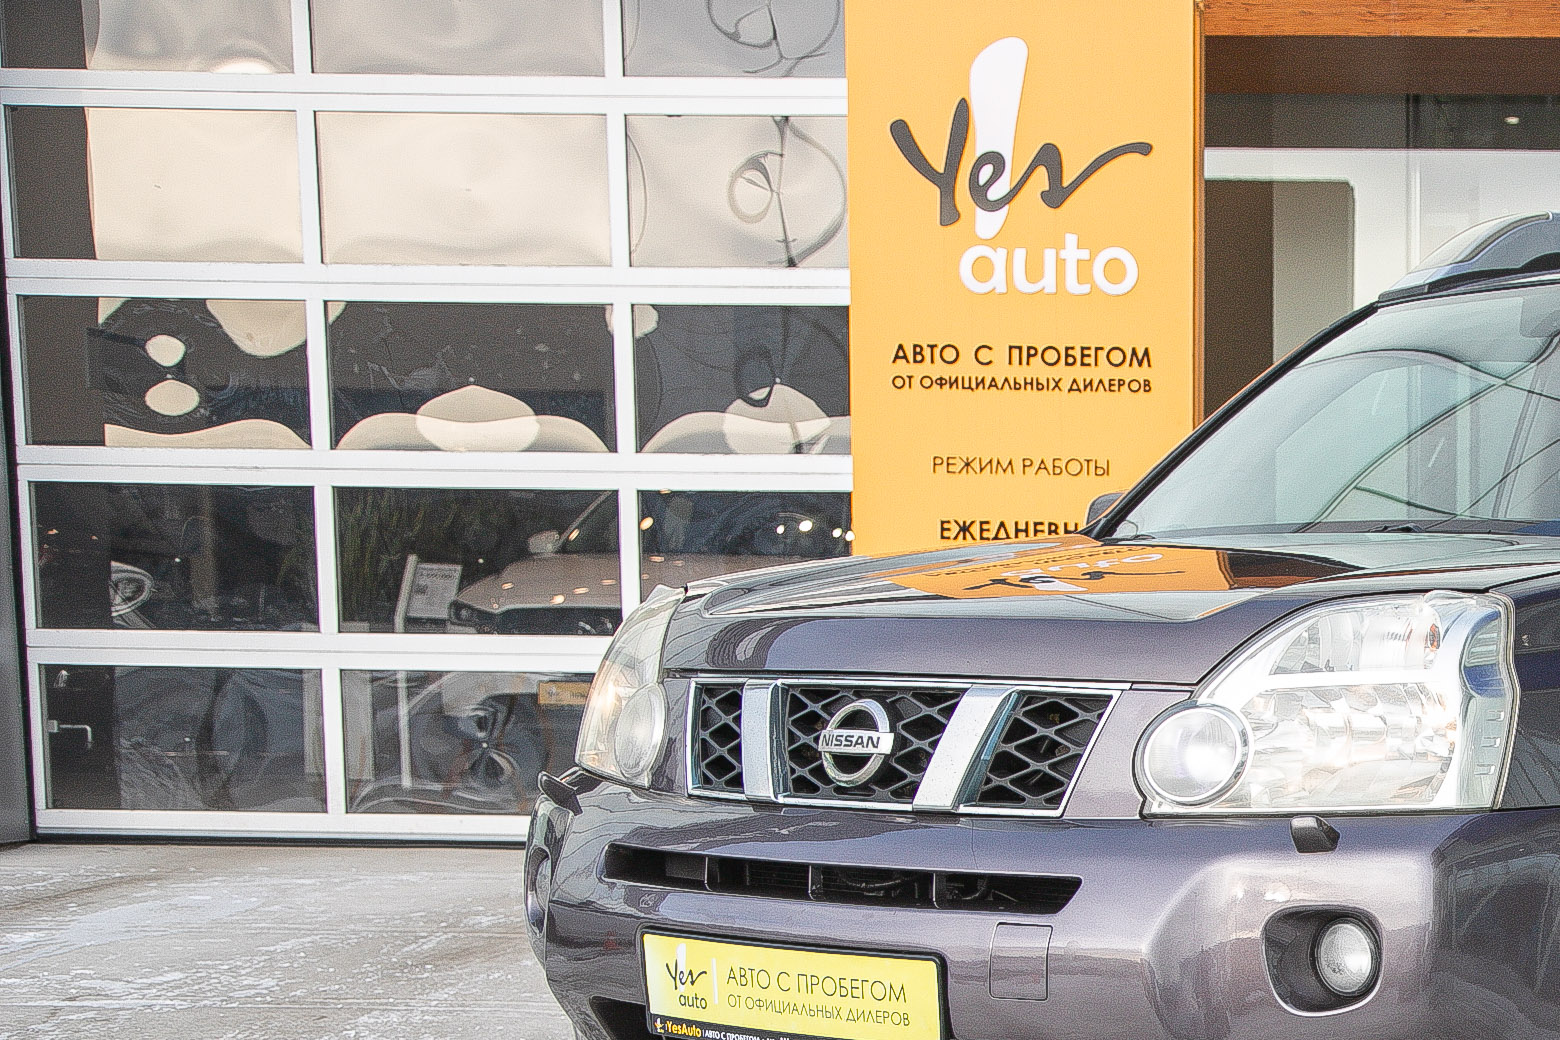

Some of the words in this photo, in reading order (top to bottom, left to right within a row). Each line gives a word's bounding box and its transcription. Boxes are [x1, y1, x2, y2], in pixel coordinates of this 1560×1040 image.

[889, 96, 1153, 227] Yes
[958, 232, 1139, 296] auto
[891, 343, 960, 365] АВТО
[974, 344, 993, 366] С
[1007, 345, 1152, 368] ПРОБЕГОМ
[891, 374, 914, 390] ОТ
[919, 374, 1063, 393] ОФИЦИАЛЬНЫХ
[1067, 377, 1152, 394] ДИЛЕРОВ
[931, 455, 1015, 475] РЕЖИМ
[1021, 457, 1110, 477] РАБОТЫ
[939, 519, 1079, 541] ЕЖЕДНЕВН
[821, 733, 880, 749] NISSAN
[665, 958, 707, 991] Yes
[726, 966, 771, 989] АВТО
[776, 971, 791, 992] С
[797, 973, 907, 1003] ПРОБЕГОМ
[678, 992, 708, 1010] auto
[727, 993, 742, 1009] ОТ
[744, 996, 843, 1021] ОФИЦИАЛЬНЫХ
[846, 1007, 911, 1027] ДИЛЕРОВ
[666, 1020, 702, 1038] YesAuto
[704, 1031, 721, 1040] АВТО
